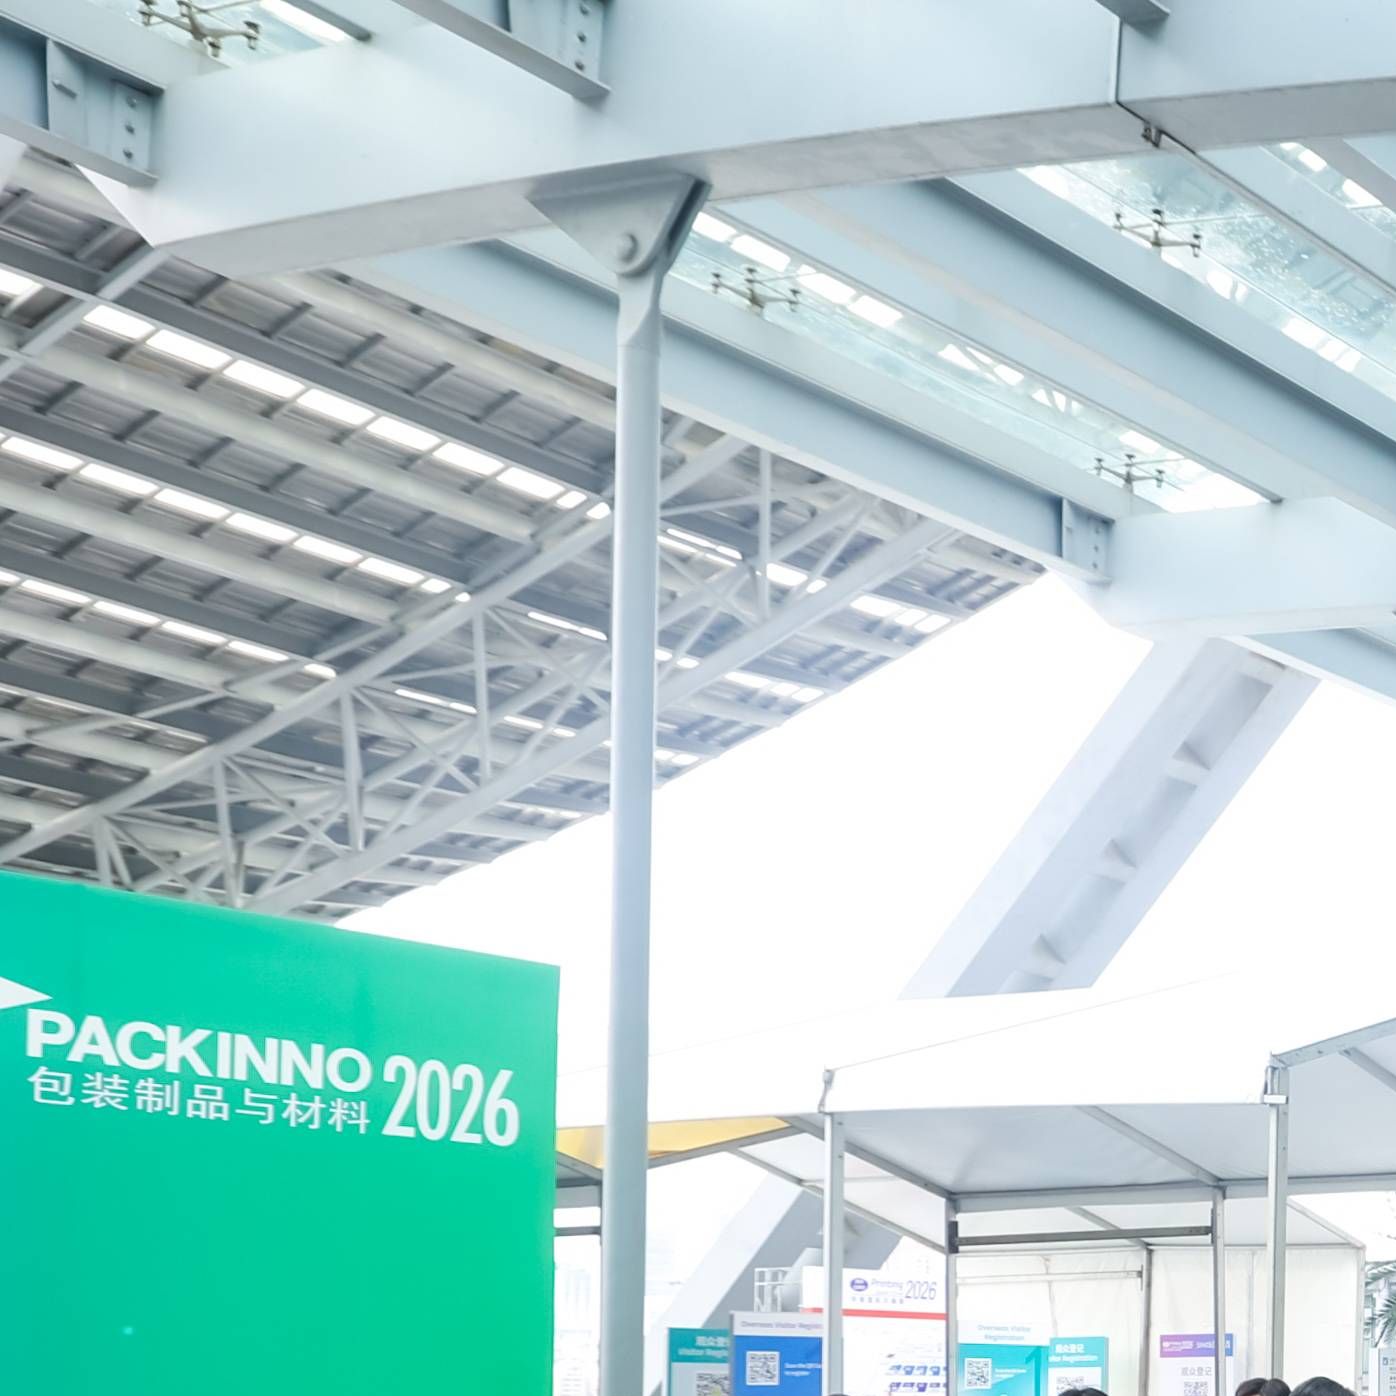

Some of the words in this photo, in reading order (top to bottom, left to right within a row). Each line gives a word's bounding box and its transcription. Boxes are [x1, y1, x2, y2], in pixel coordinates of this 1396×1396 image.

[26, 1007, 373, 1093] PACKINNO
[380, 1054, 520, 1148] 2026
[27, 1065, 371, 1135] 包装制品与材料
